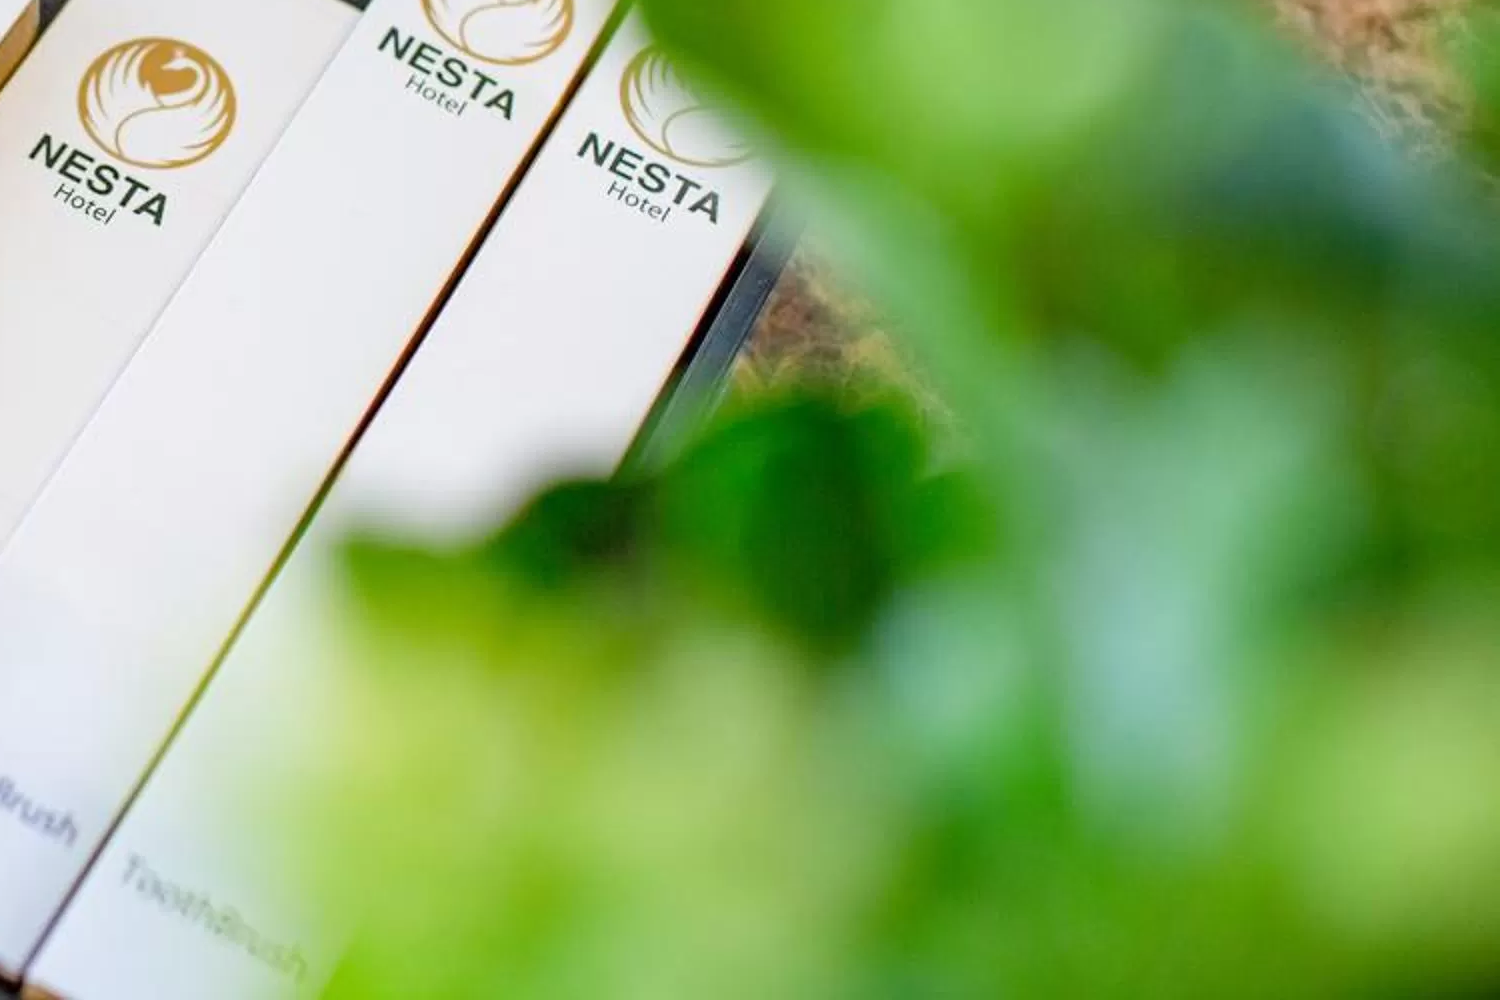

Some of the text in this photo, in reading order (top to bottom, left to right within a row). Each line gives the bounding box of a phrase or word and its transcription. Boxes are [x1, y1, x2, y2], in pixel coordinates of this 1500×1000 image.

[378, 25, 516, 121] NESTA
[404, 73, 468, 117] Hotel
[28, 133, 167, 228] NESTA
[53, 183, 118, 226] Hotel
[577, 132, 721, 224] NESTA
[606, 180, 671, 224] Hotel
